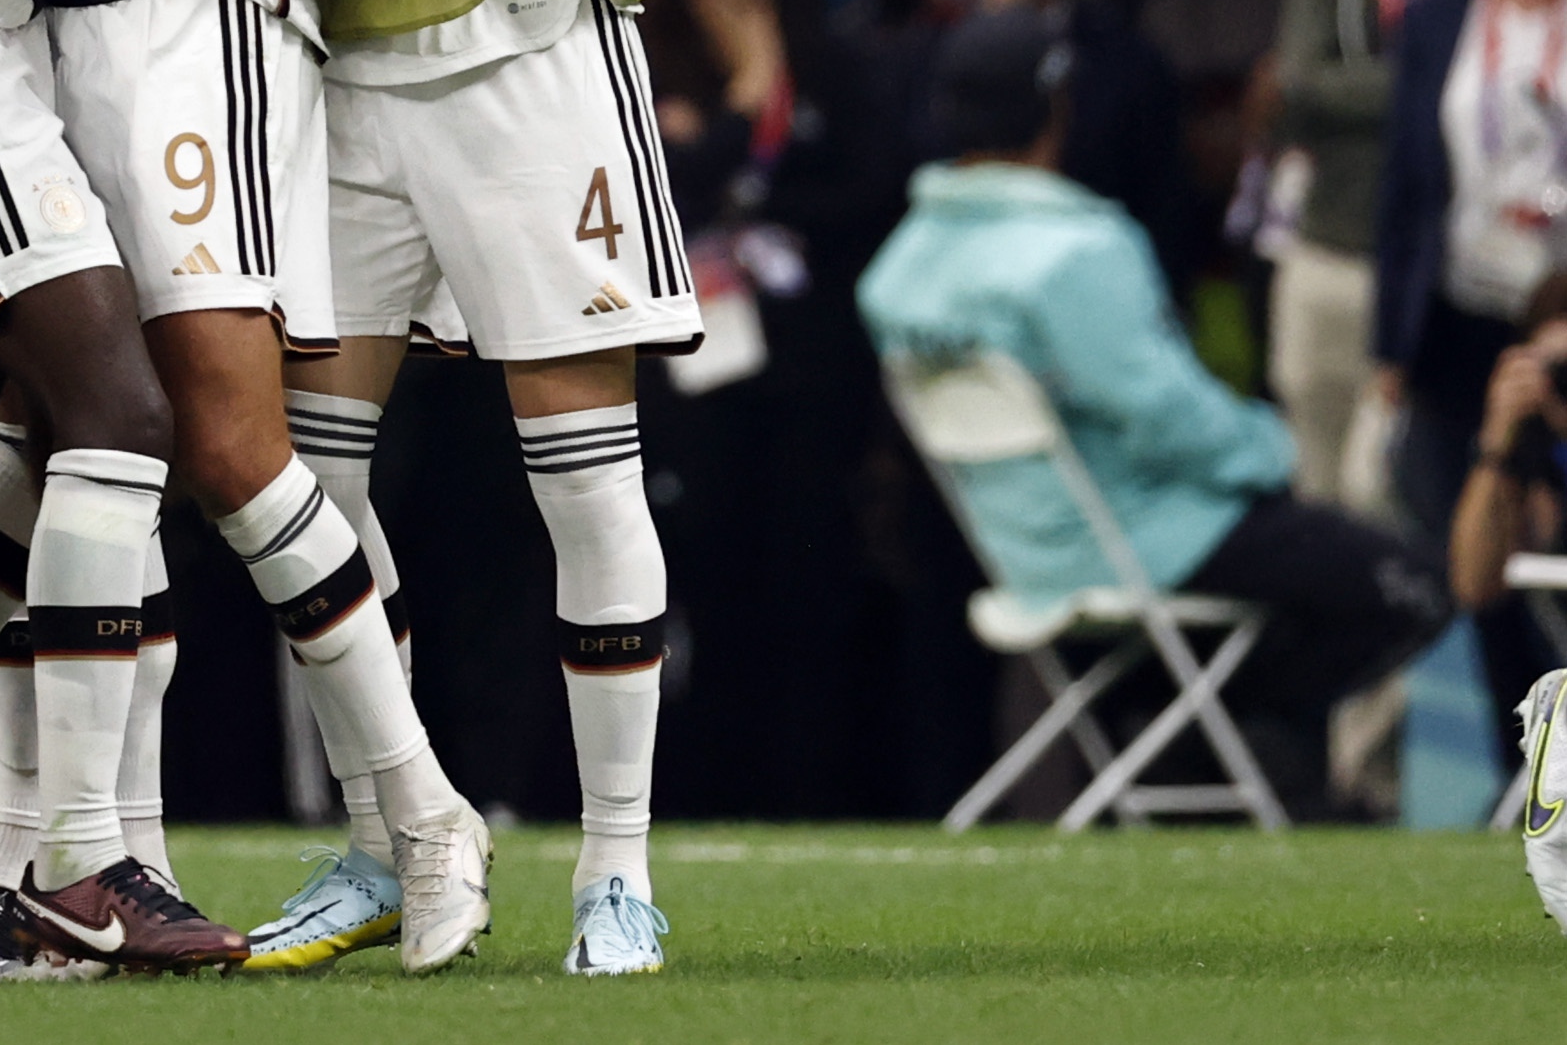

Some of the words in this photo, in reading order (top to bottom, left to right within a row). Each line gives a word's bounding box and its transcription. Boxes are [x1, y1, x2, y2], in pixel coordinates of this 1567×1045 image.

[164, 132, 216, 225] 9
[575, 166, 624, 260] 4
[97, 619, 143, 636] DFB
[579, 635, 642, 653] DFB
